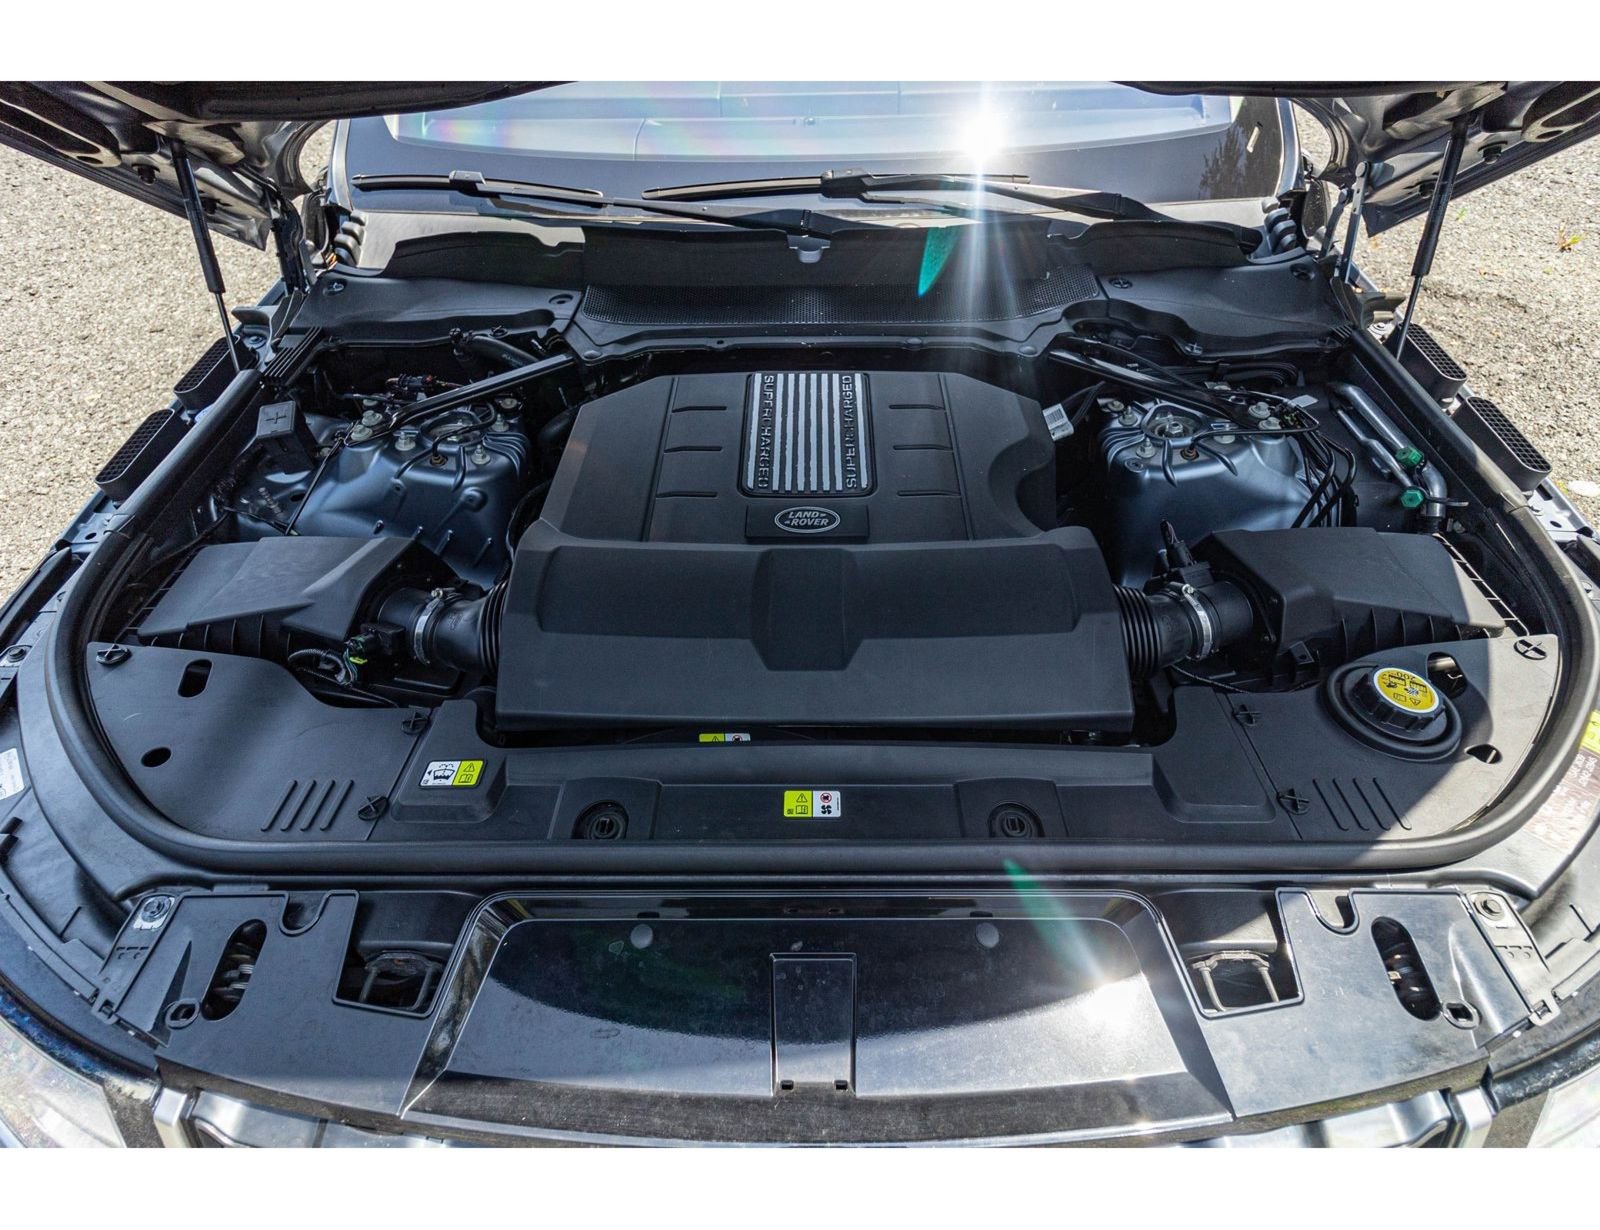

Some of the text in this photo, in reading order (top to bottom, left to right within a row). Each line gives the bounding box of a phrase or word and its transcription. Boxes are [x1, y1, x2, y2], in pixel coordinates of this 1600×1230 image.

[758, 375, 774, 488] SUPERCHARGED
[842, 375, 857, 488] SUPERCHARGED
[790, 518, 829, 526] ROVER
